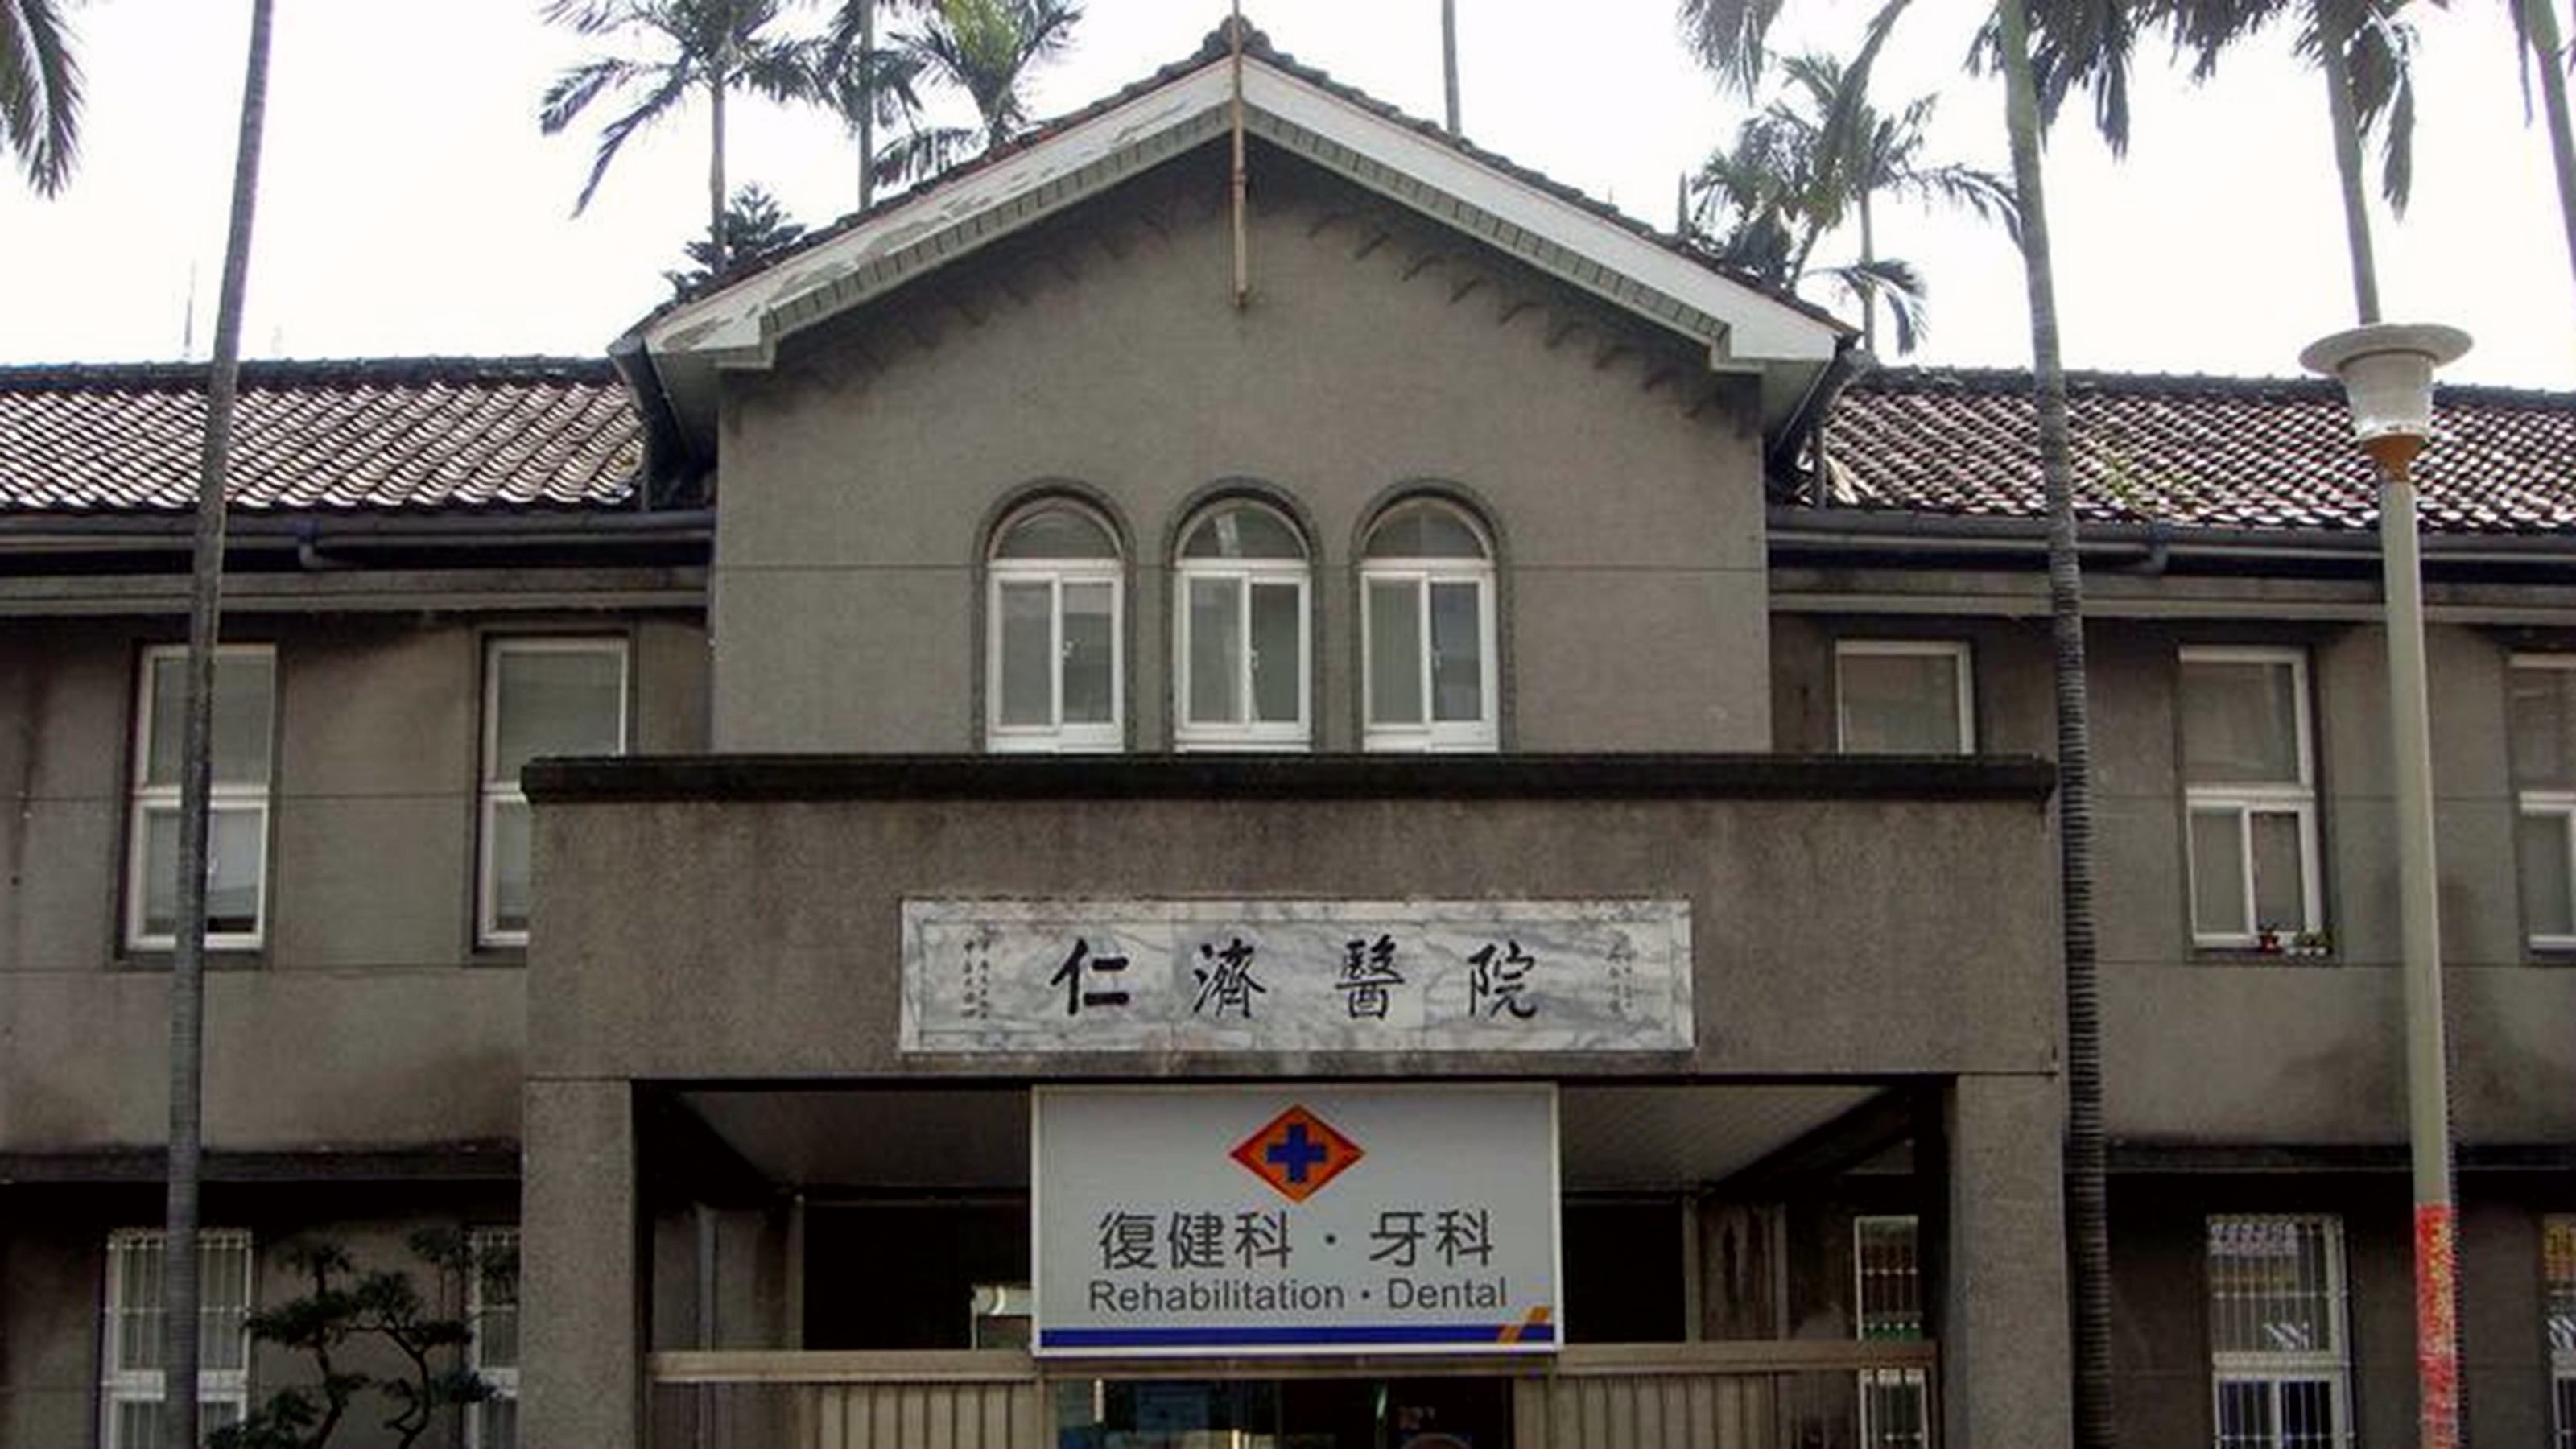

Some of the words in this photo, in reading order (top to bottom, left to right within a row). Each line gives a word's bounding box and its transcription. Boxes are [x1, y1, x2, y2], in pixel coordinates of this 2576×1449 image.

[1051, 935, 1538, 1020] 仁濟醫院
[1089, 1279, 1344, 1312] Rehabilitation
[1388, 1277, 1506, 1309] Dental
